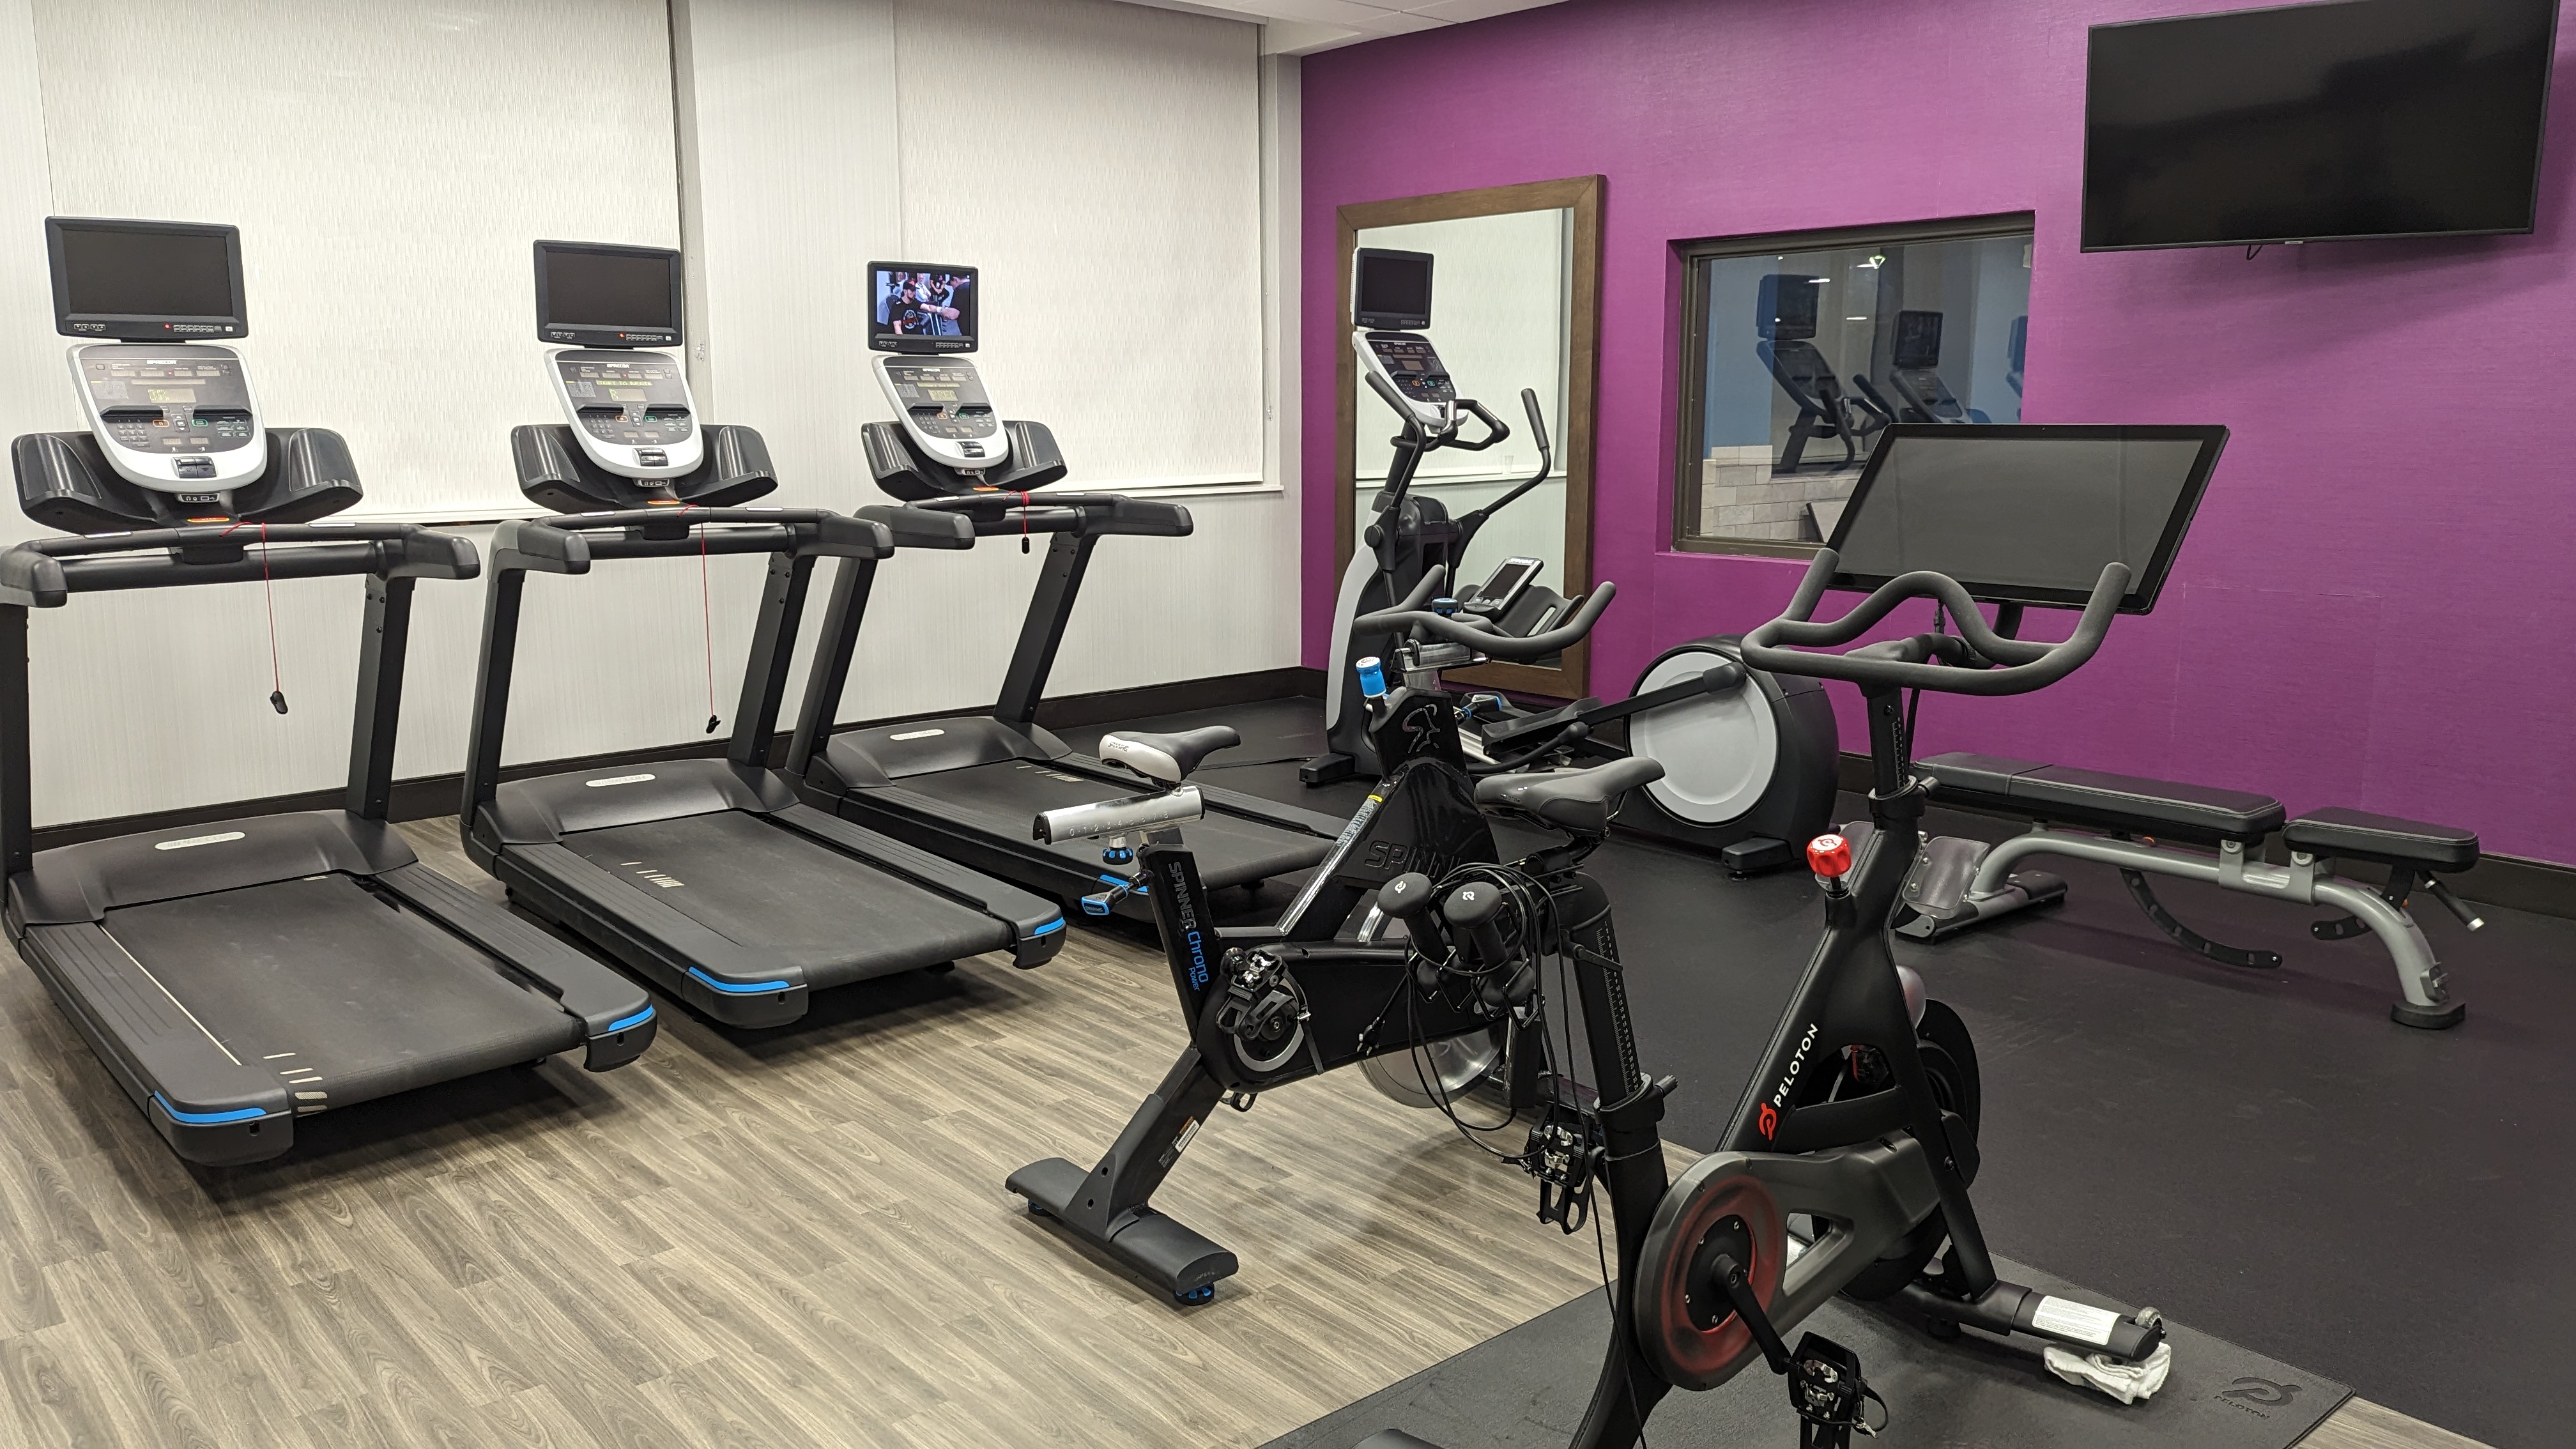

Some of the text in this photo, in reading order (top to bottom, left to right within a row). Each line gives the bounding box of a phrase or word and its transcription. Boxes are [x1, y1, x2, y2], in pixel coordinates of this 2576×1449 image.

[1168, 861, 1197, 930] SPINNER
[1187, 930, 1209, 983] Chrono
[1188, 967, 1200, 992] Power
[1773, 1023, 1818, 1108] PELOTON
